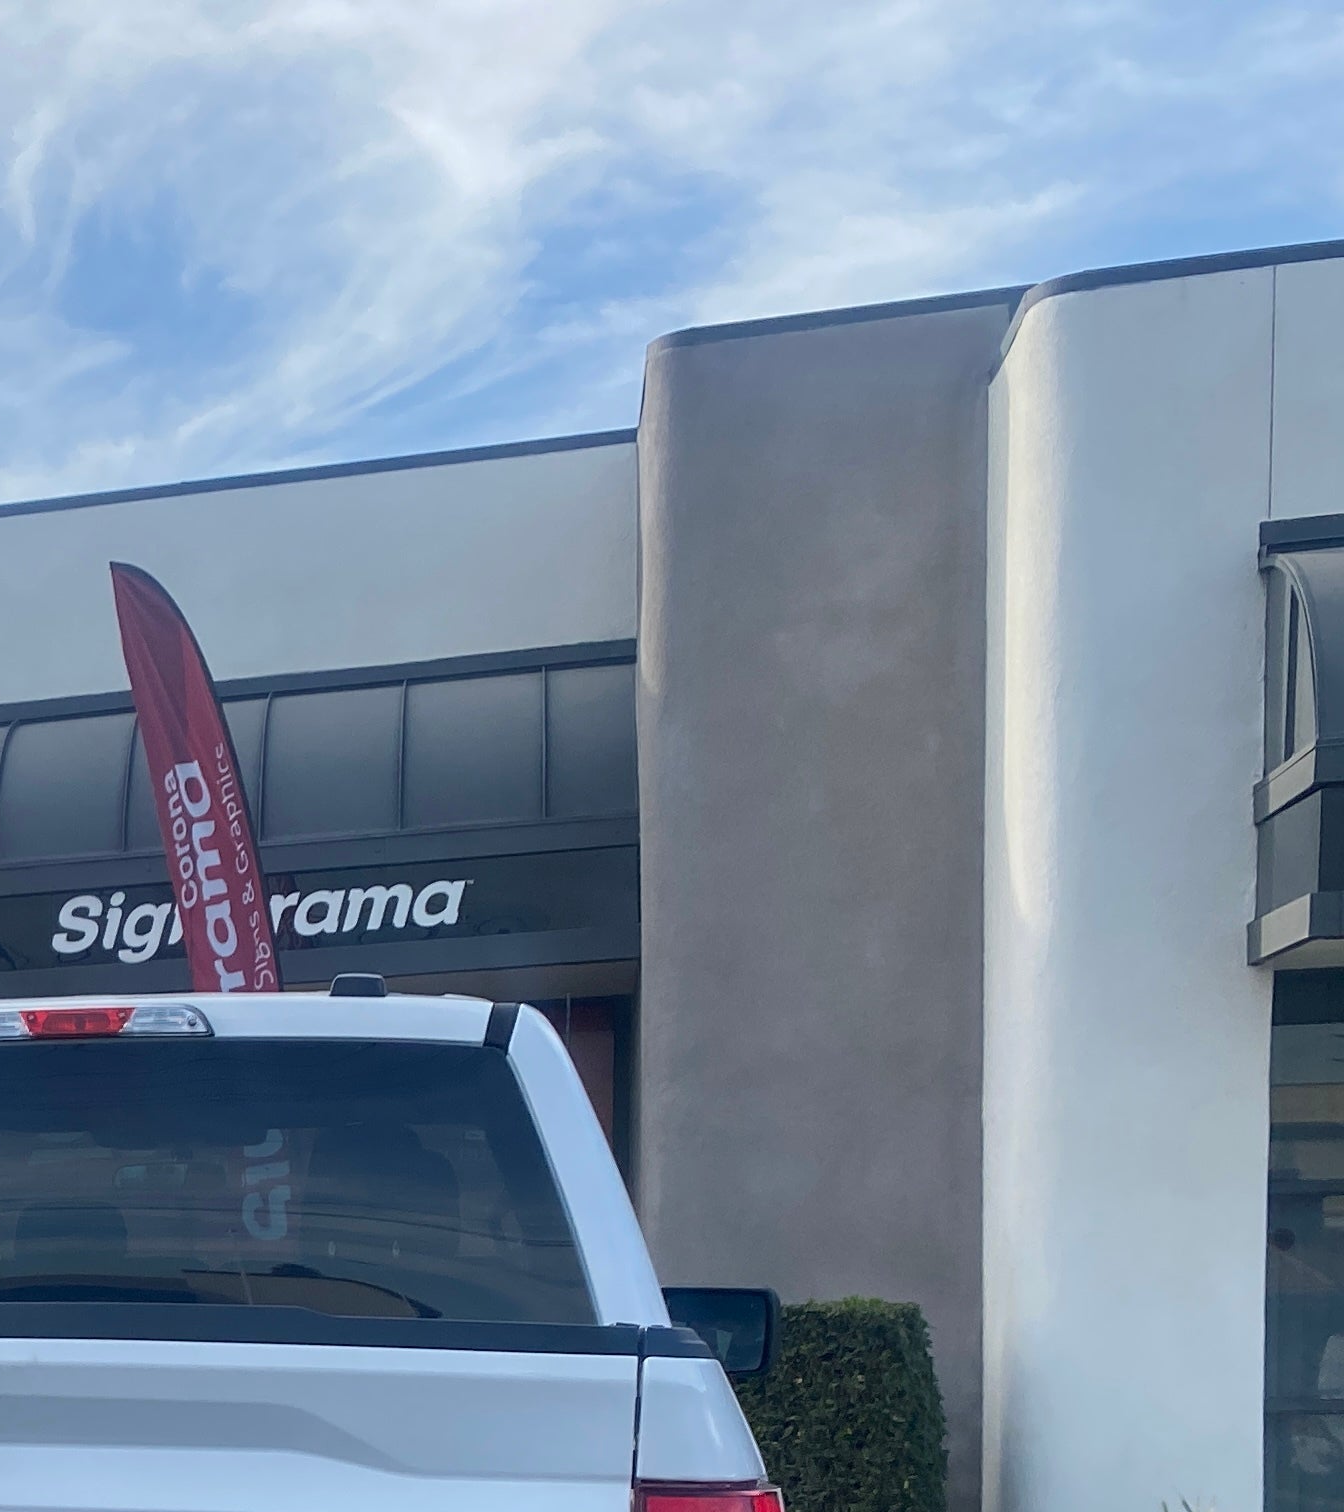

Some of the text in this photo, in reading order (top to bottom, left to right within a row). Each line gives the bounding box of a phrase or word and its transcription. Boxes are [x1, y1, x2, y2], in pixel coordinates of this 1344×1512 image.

[164, 769, 198, 909] Corona
[175, 760, 246, 992] rama
[51, 879, 467, 964] Sigrama
[242, 879, 256, 905] &
[249, 911, 274, 990] Signs
